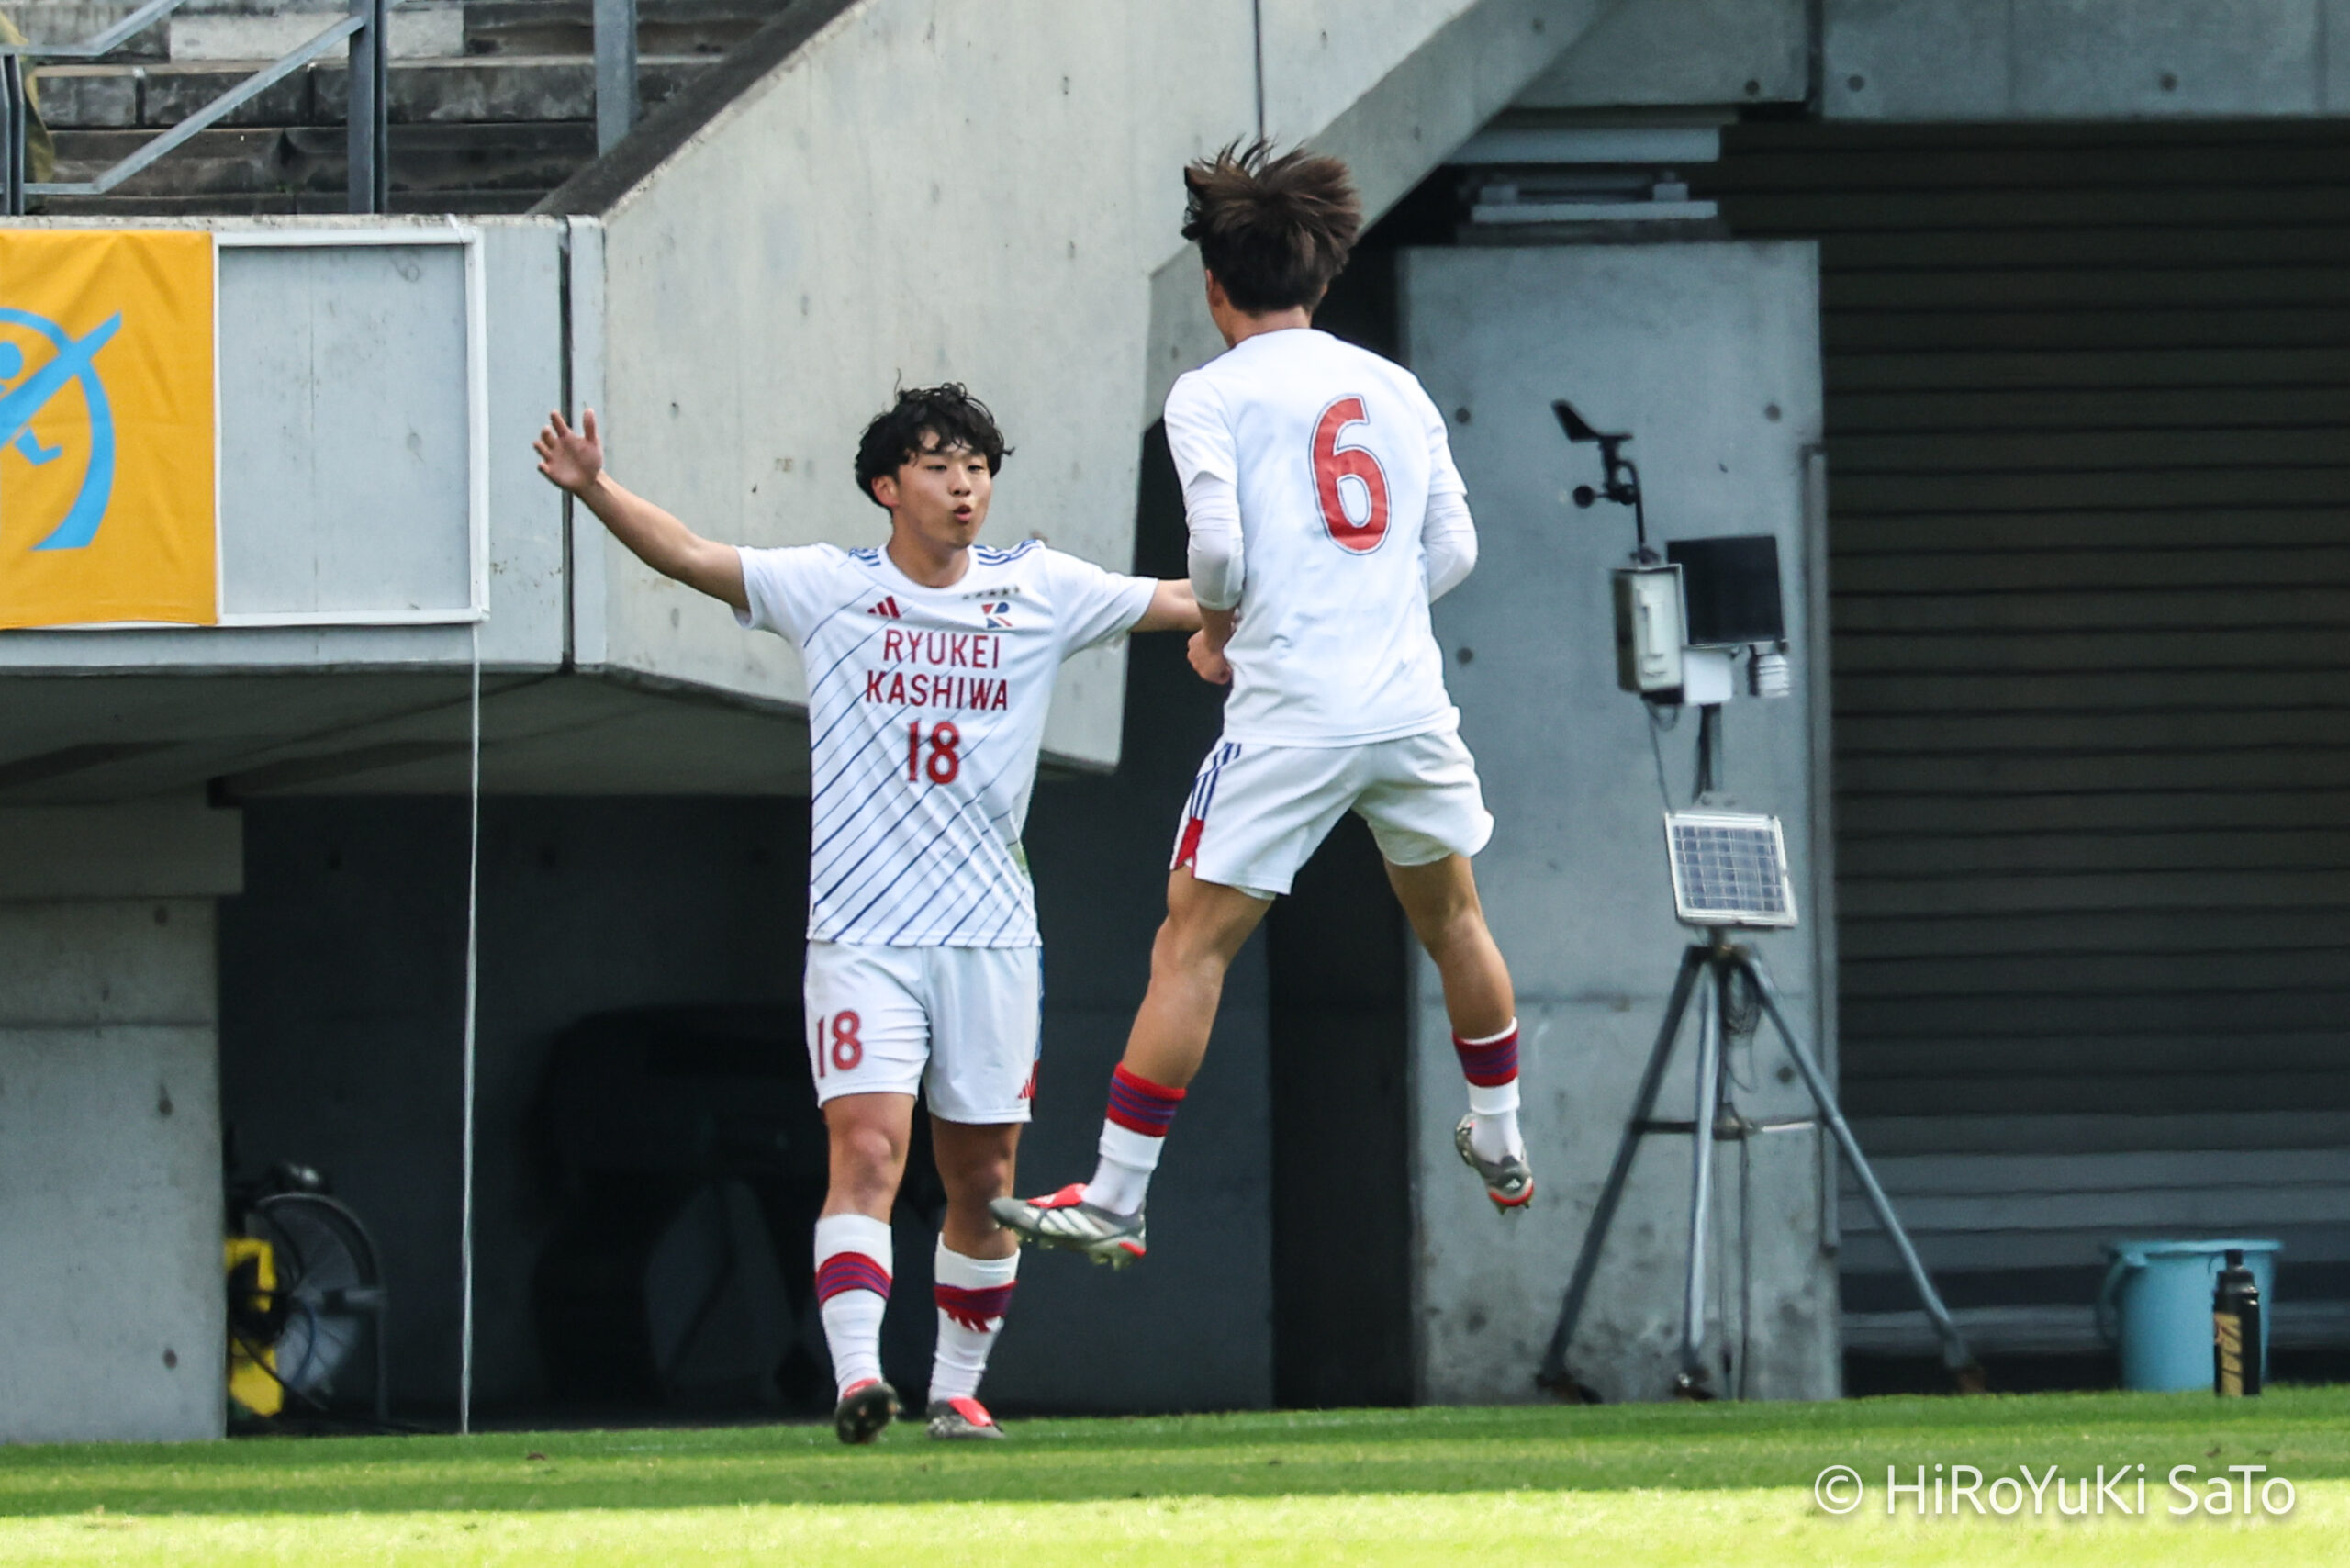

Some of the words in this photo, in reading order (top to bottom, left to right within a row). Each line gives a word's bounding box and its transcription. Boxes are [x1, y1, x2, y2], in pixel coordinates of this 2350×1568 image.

[1309, 394, 1391, 555] 6
[884, 630, 999, 669] RYUKEI
[866, 670, 1008, 711] KASHIWA
[907, 720, 960, 784] 18
[817, 1009, 864, 1078] 18
